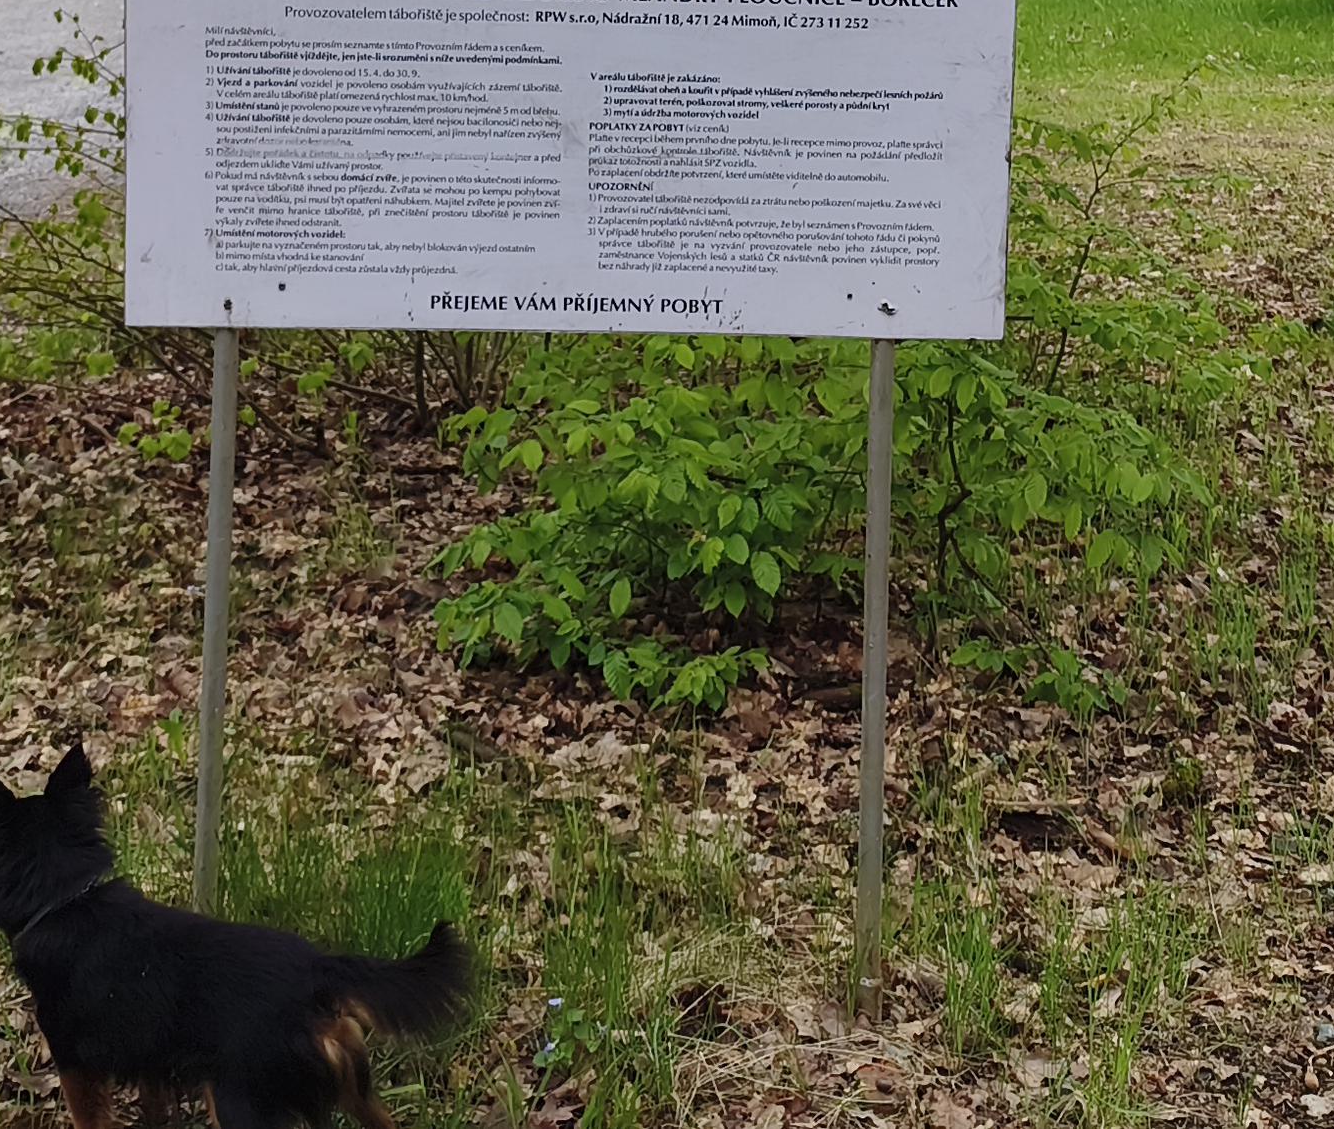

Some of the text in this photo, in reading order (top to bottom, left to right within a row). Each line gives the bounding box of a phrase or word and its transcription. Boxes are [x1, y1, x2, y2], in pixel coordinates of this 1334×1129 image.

[285, 6, 386, 18] Provozovatelem
[388, 7, 443, 20] tábořiště
[445, 8, 457, 23] je
[458, 9, 529, 23] společnost:
[535, 10, 567, 22] RPW
[602, 11, 662, 24] Nádražní
[664, 13, 683, 27] 18,
[685, 14, 708, 25] 471
[713, 14, 728, 26] 24
[731, 14, 780, 28] Mimoň,
[783, 12, 798, 28] IČ
[800, 16, 824, 28] 273
[827, 17, 840, 28] 11
[844, 17, 868, 29] 252
[430, 291, 723, 313] PŘEJEME VÁM PŘÍJEMNÝ POBYT
